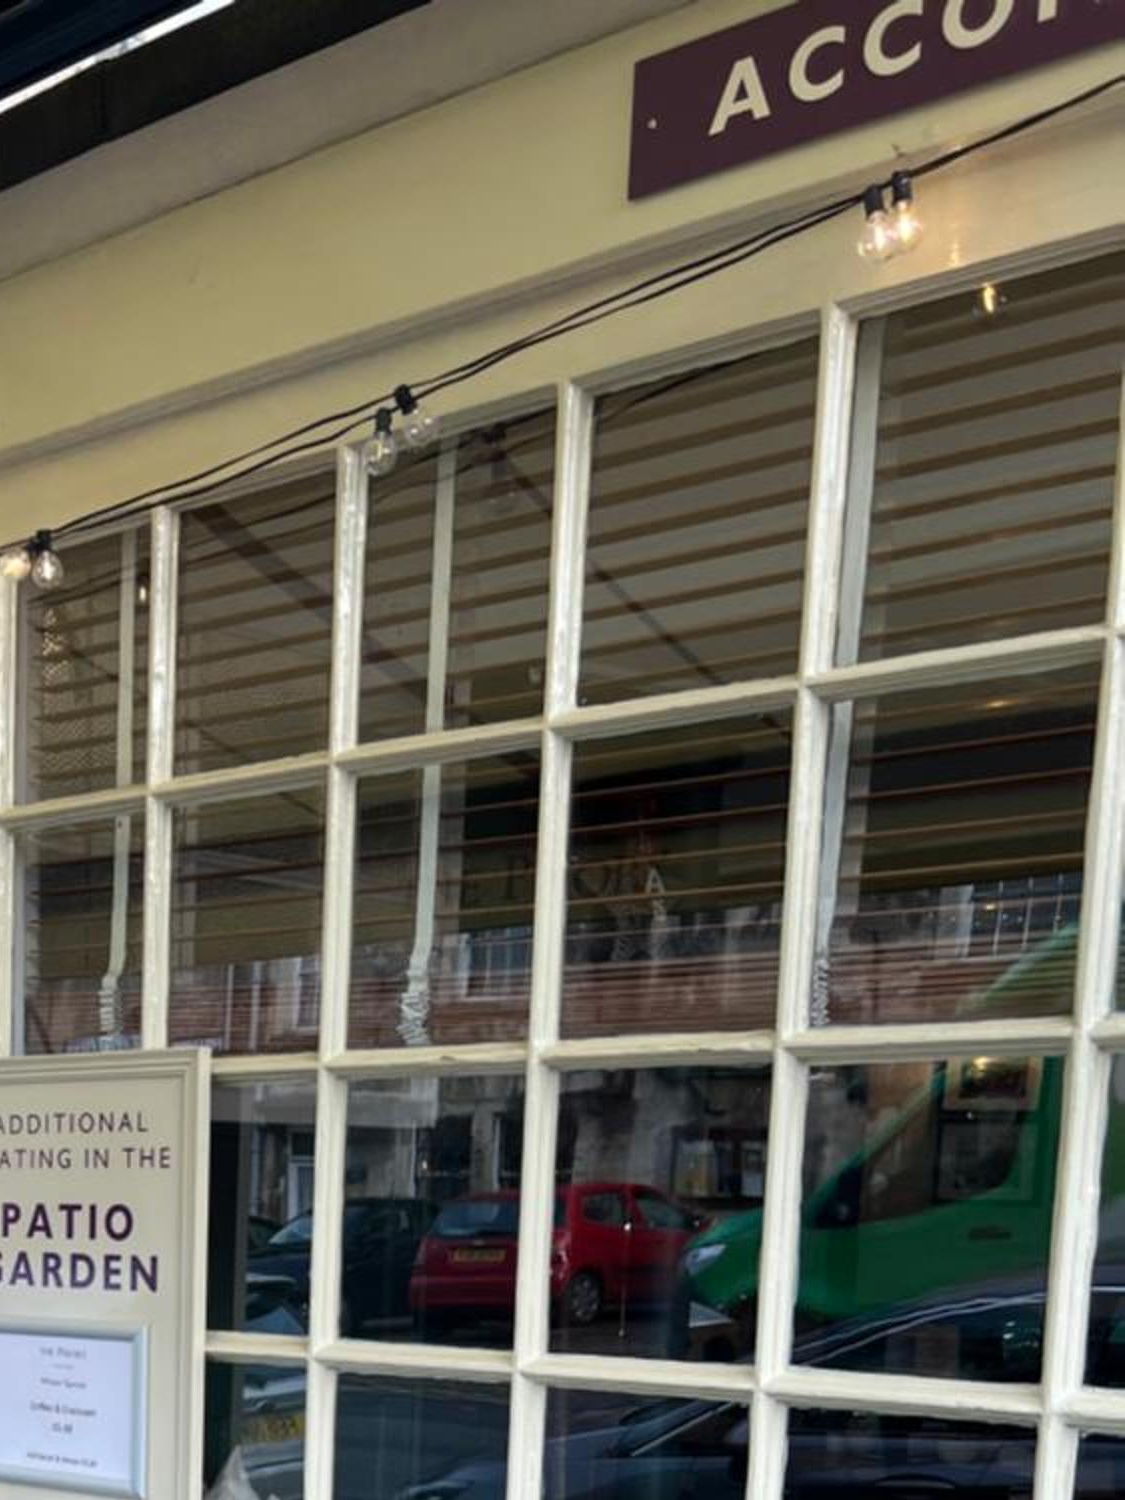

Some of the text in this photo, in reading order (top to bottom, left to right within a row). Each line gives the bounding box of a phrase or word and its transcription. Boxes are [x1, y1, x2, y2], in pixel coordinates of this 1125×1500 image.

[707, 0, 1059, 136] ACCO
[83, 1147, 109, 1169] IN
[121, 1145, 172, 1169] THE
[1, 1202, 134, 1241] PATIO
